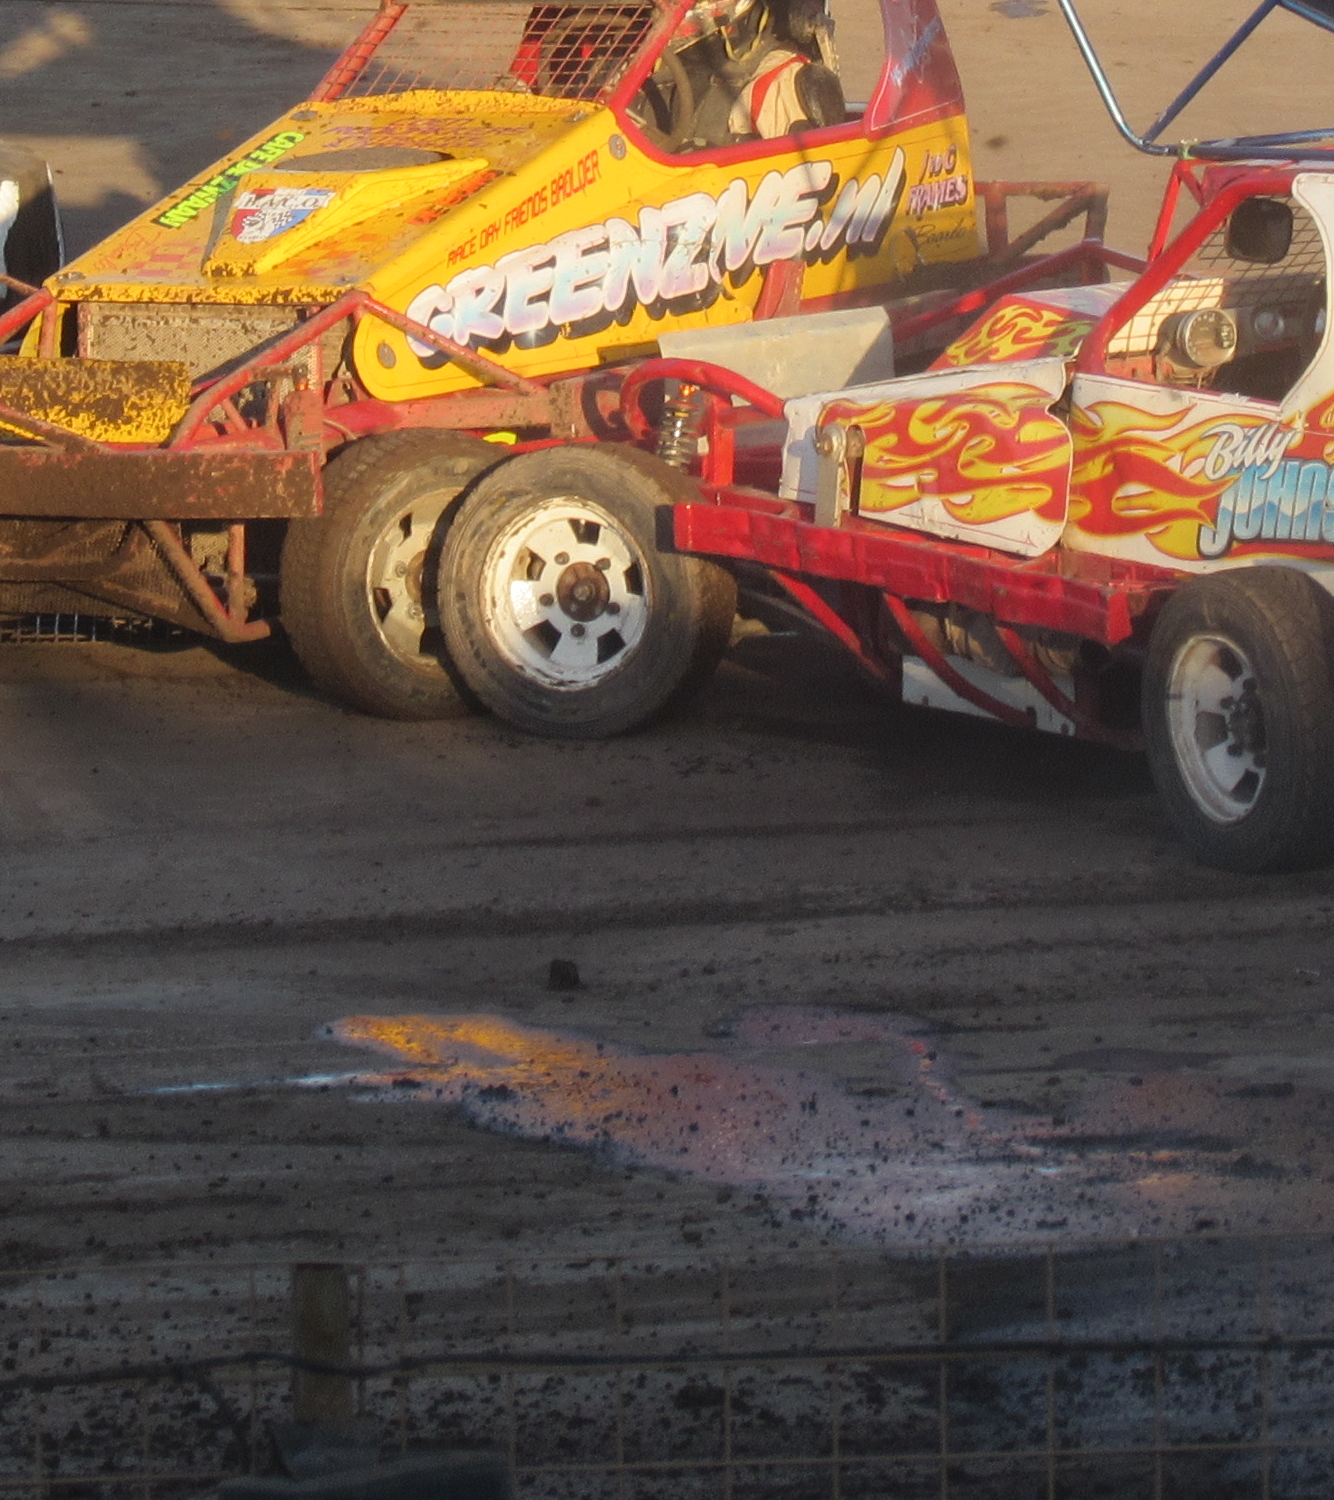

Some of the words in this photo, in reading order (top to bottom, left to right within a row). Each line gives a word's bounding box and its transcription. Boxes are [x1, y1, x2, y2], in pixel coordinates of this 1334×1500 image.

[446, 240, 478, 268] RACE
[479, 220, 501, 250] DAY
[504, 187, 548, 236] FRIENDS
[1200, 421, 1297, 481] Billy
